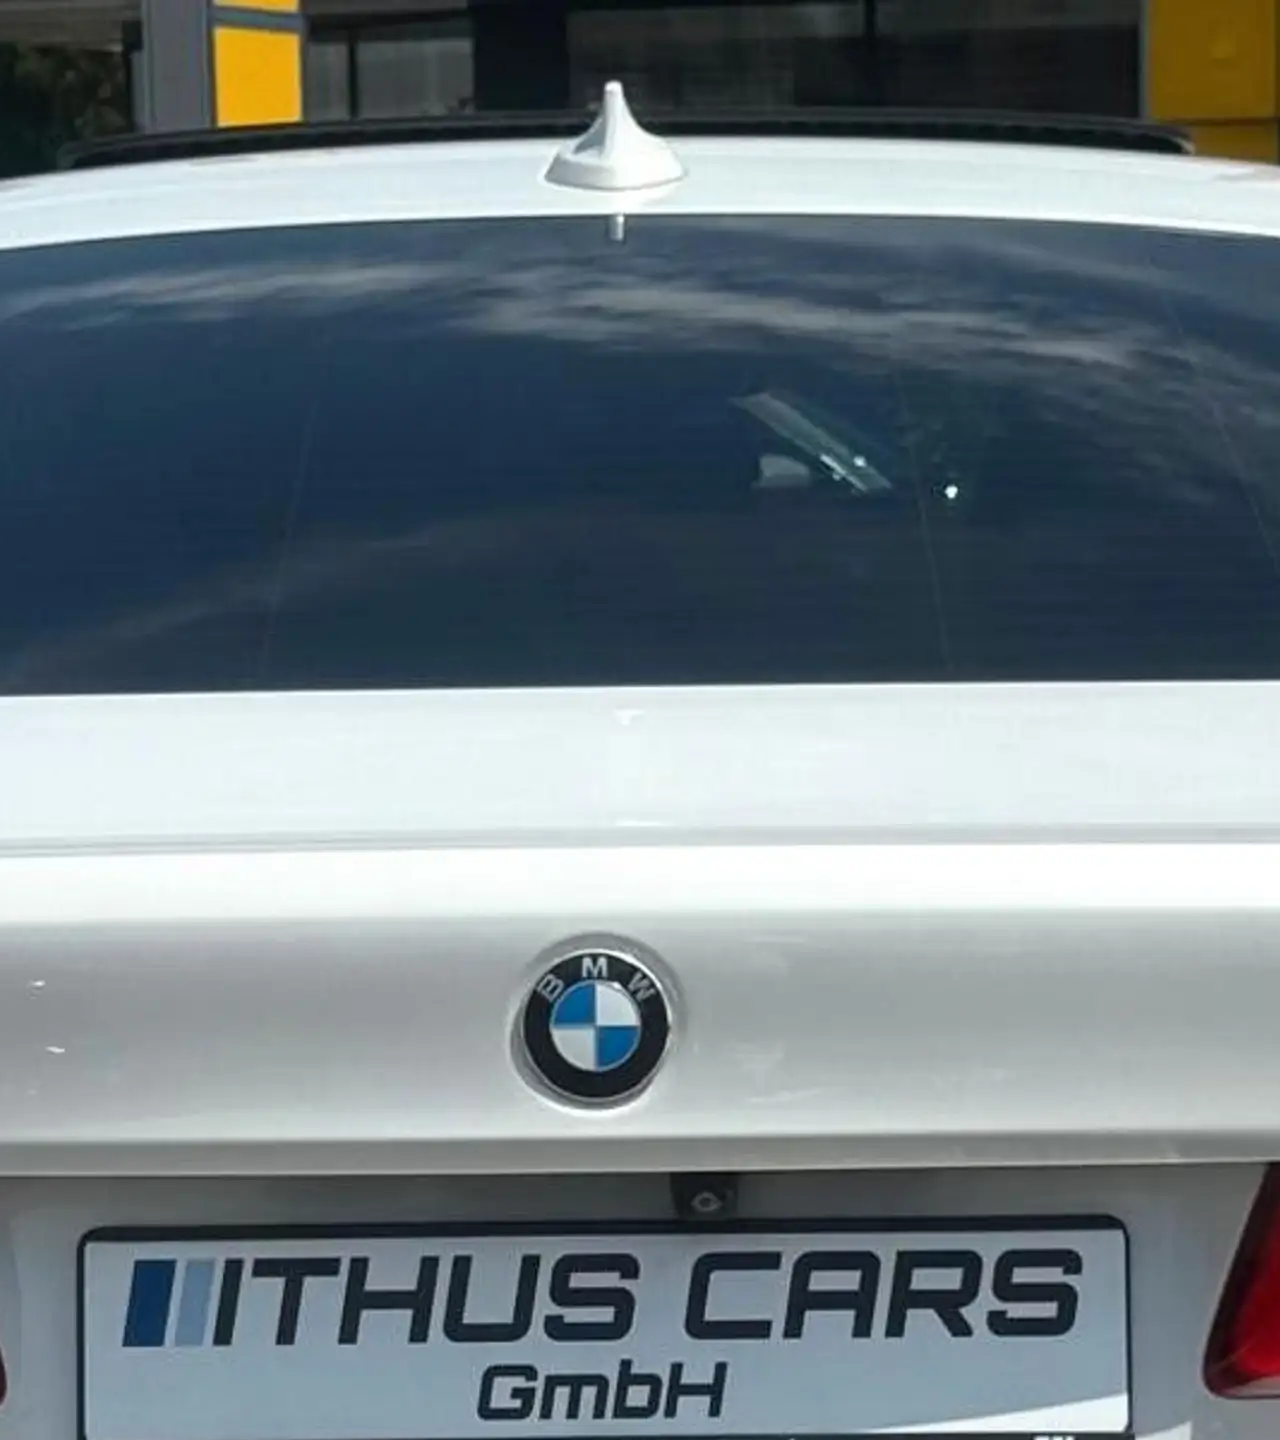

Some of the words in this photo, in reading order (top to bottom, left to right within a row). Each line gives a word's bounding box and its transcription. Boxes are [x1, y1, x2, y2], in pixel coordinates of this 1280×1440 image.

[537, 956, 657, 1003] BMW
[685, 1248, 1083, 1341] CARS
[477, 1359, 728, 1421] GmbH
